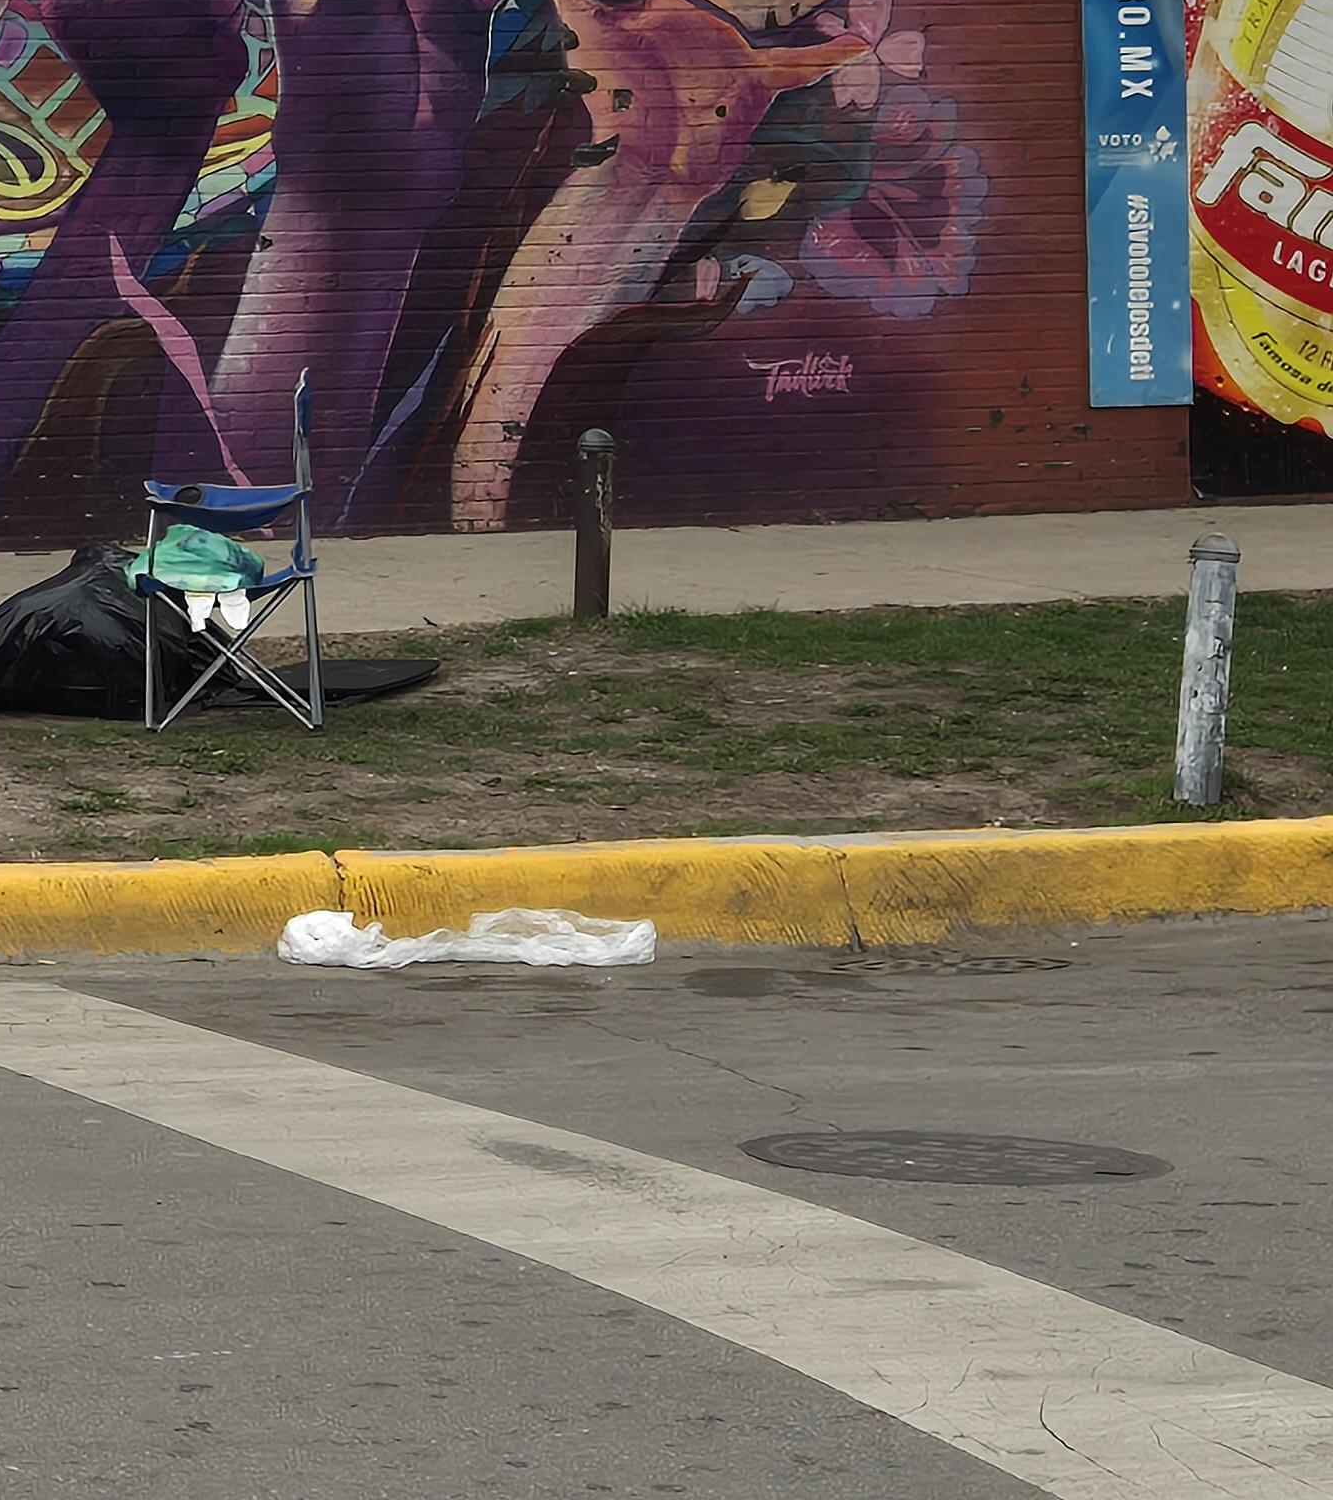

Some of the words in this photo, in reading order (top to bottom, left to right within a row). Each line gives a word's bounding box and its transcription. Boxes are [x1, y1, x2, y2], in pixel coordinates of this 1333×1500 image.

[1098, 133, 1142, 147] VOTO
[1272, 240, 1333, 288] LAG
[1251, 331, 1314, 386] Famosa
[1298, 340, 1320, 364] 12
